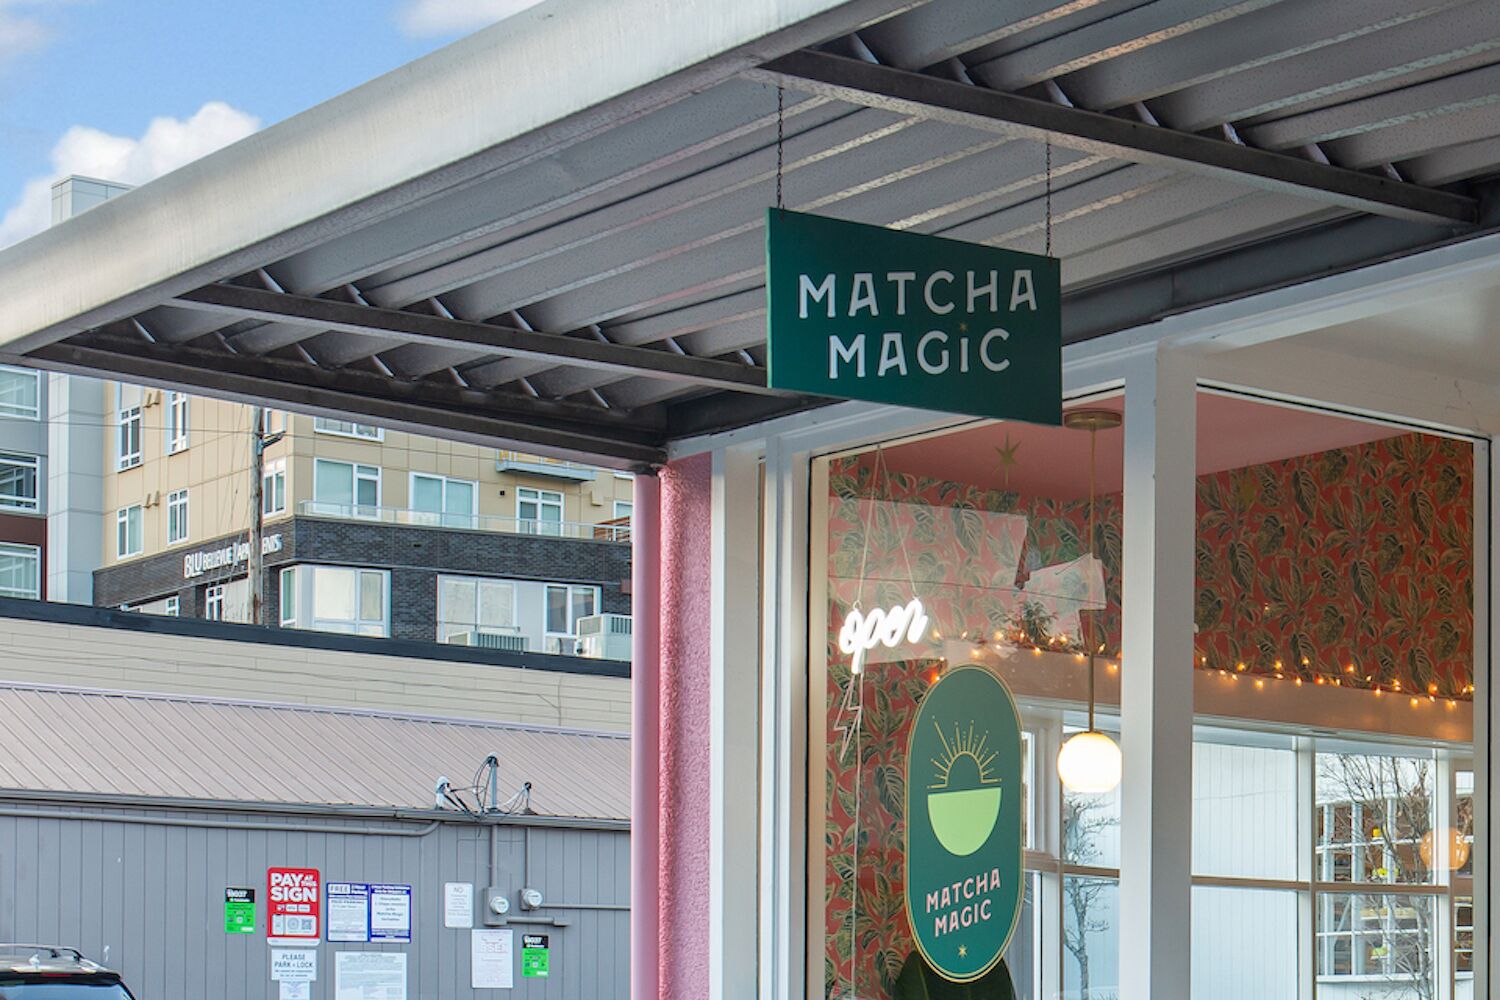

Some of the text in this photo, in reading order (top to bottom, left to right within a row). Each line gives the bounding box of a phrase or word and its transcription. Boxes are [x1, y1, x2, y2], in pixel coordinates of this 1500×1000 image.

[798, 269, 1038, 319] MATCHA
[184, 551, 204, 579] BLU
[838, 597, 929, 675] open
[270, 872, 304, 887] PAY
[330, 885, 348, 893] FREE
[453, 886, 464, 894] NO
[270, 886, 317, 903] SIGN
[926, 868, 1001, 914] MATCHA
[935, 898, 992, 938] MAGIC
[296, 961, 313, 969] LOCK
